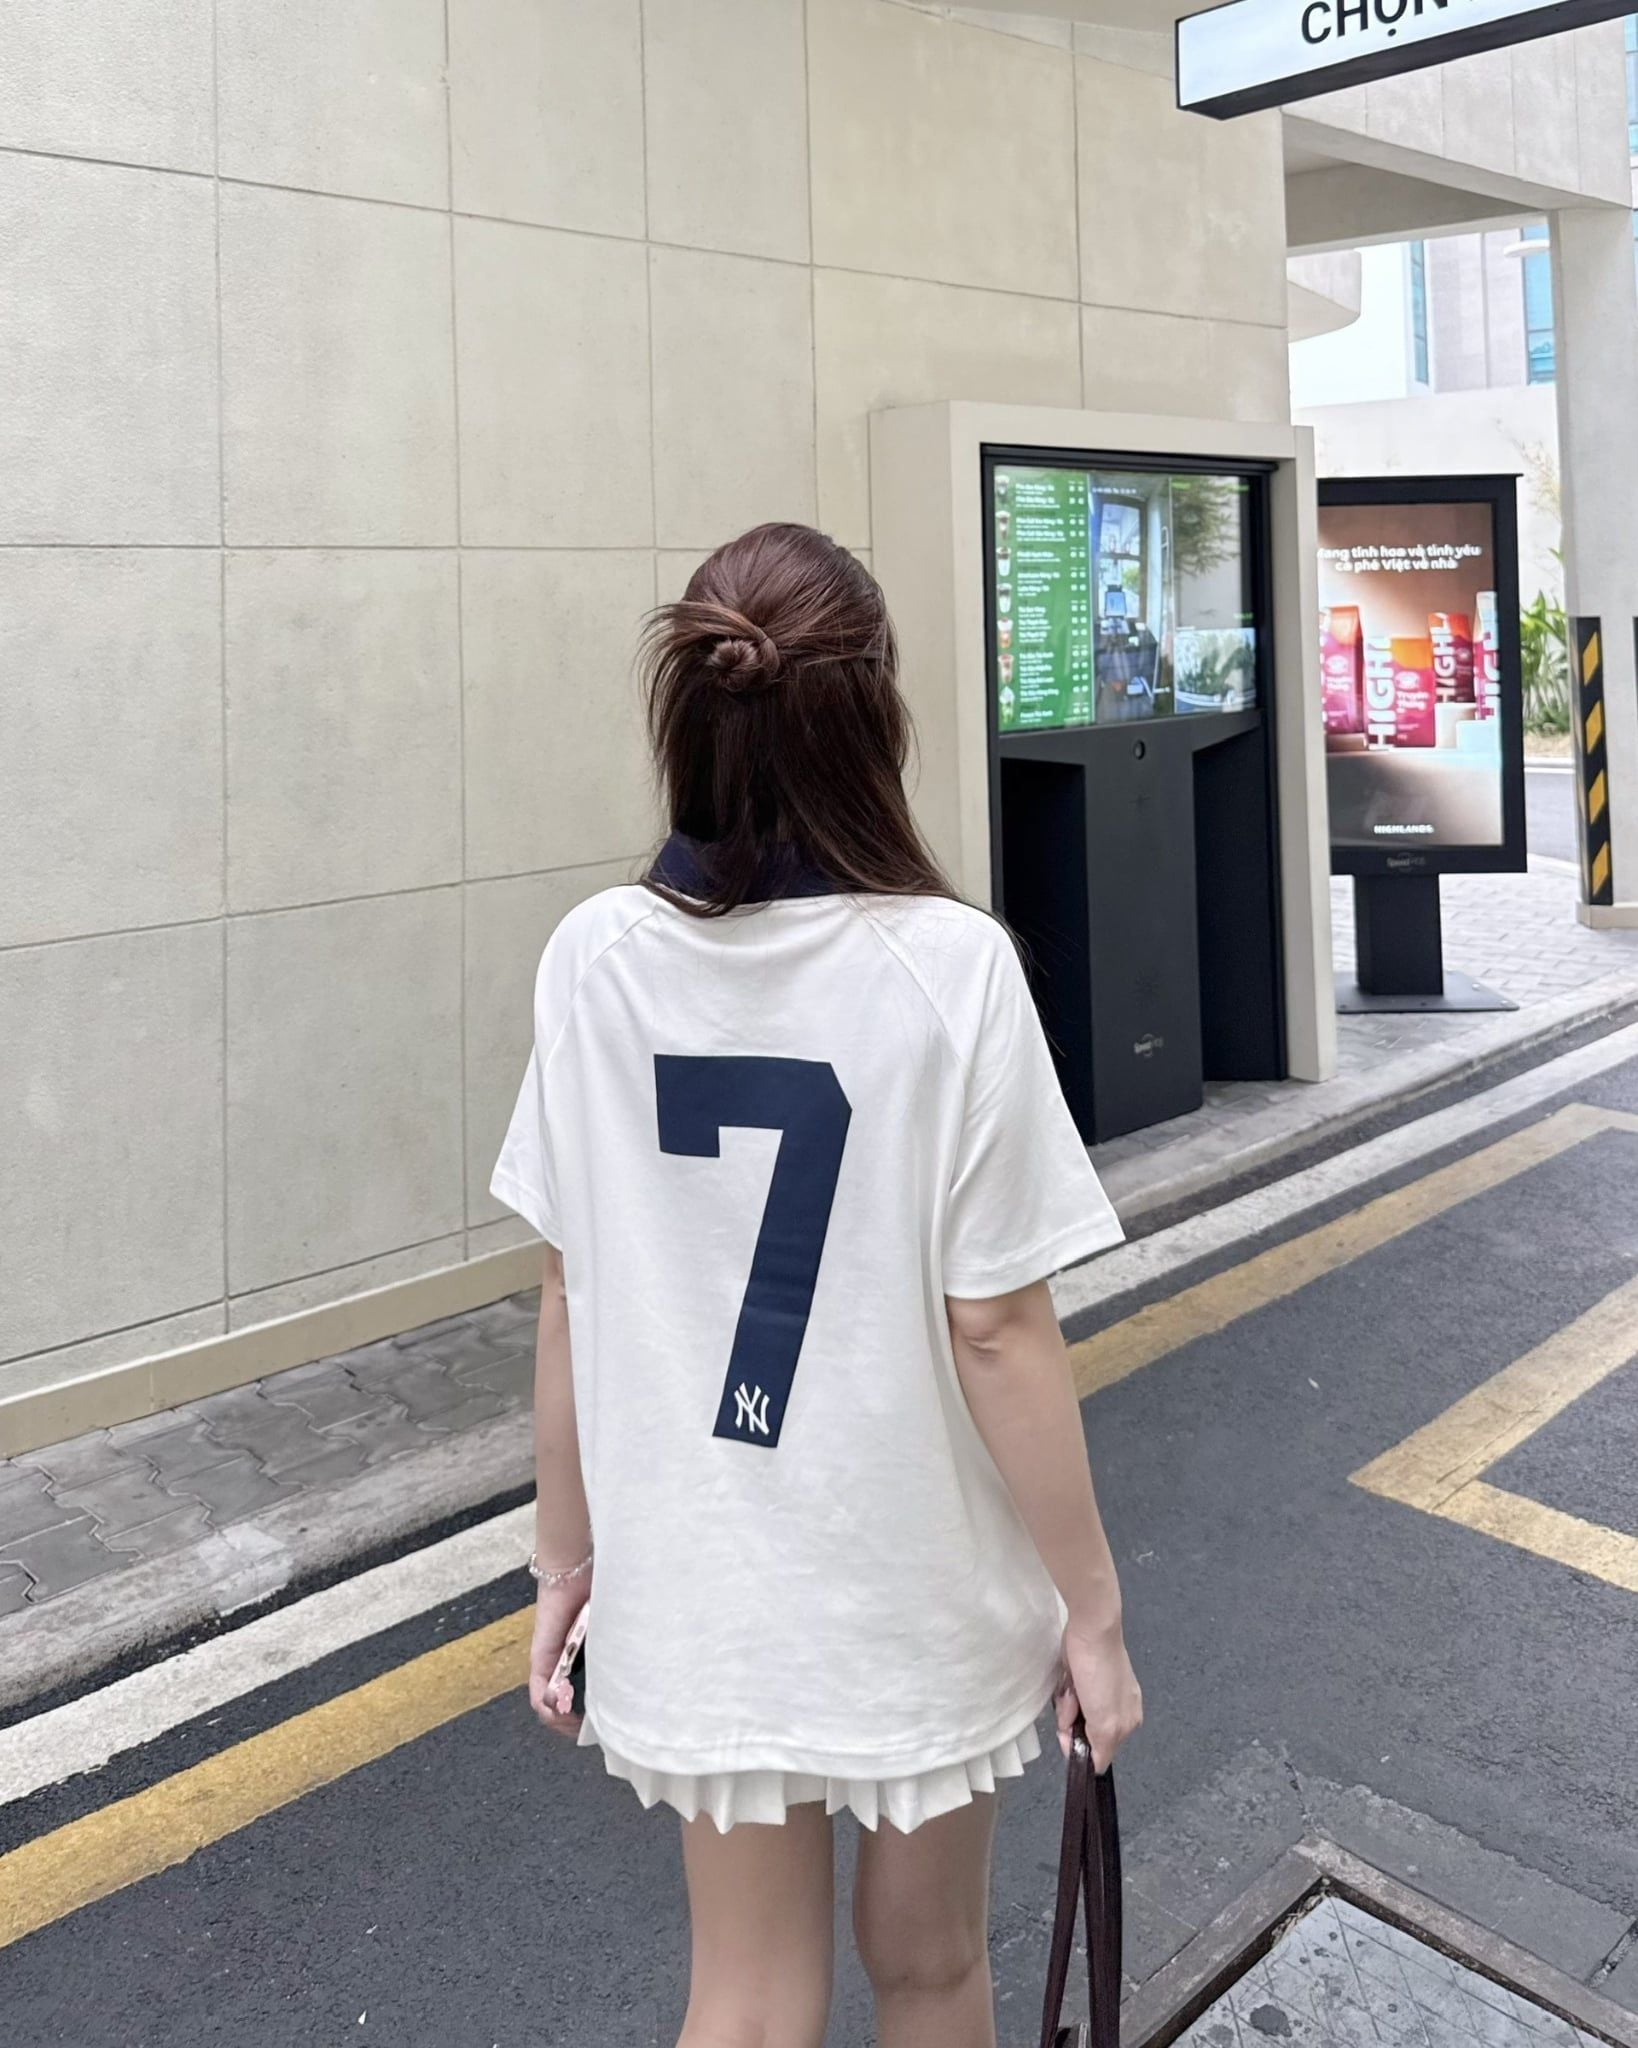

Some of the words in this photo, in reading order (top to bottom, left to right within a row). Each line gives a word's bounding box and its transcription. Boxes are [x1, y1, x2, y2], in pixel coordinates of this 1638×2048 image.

[1373, 824, 1435, 834] HIGHLANDS
[653, 1054, 851, 1448] 7
[733, 1381, 771, 1436] NY
